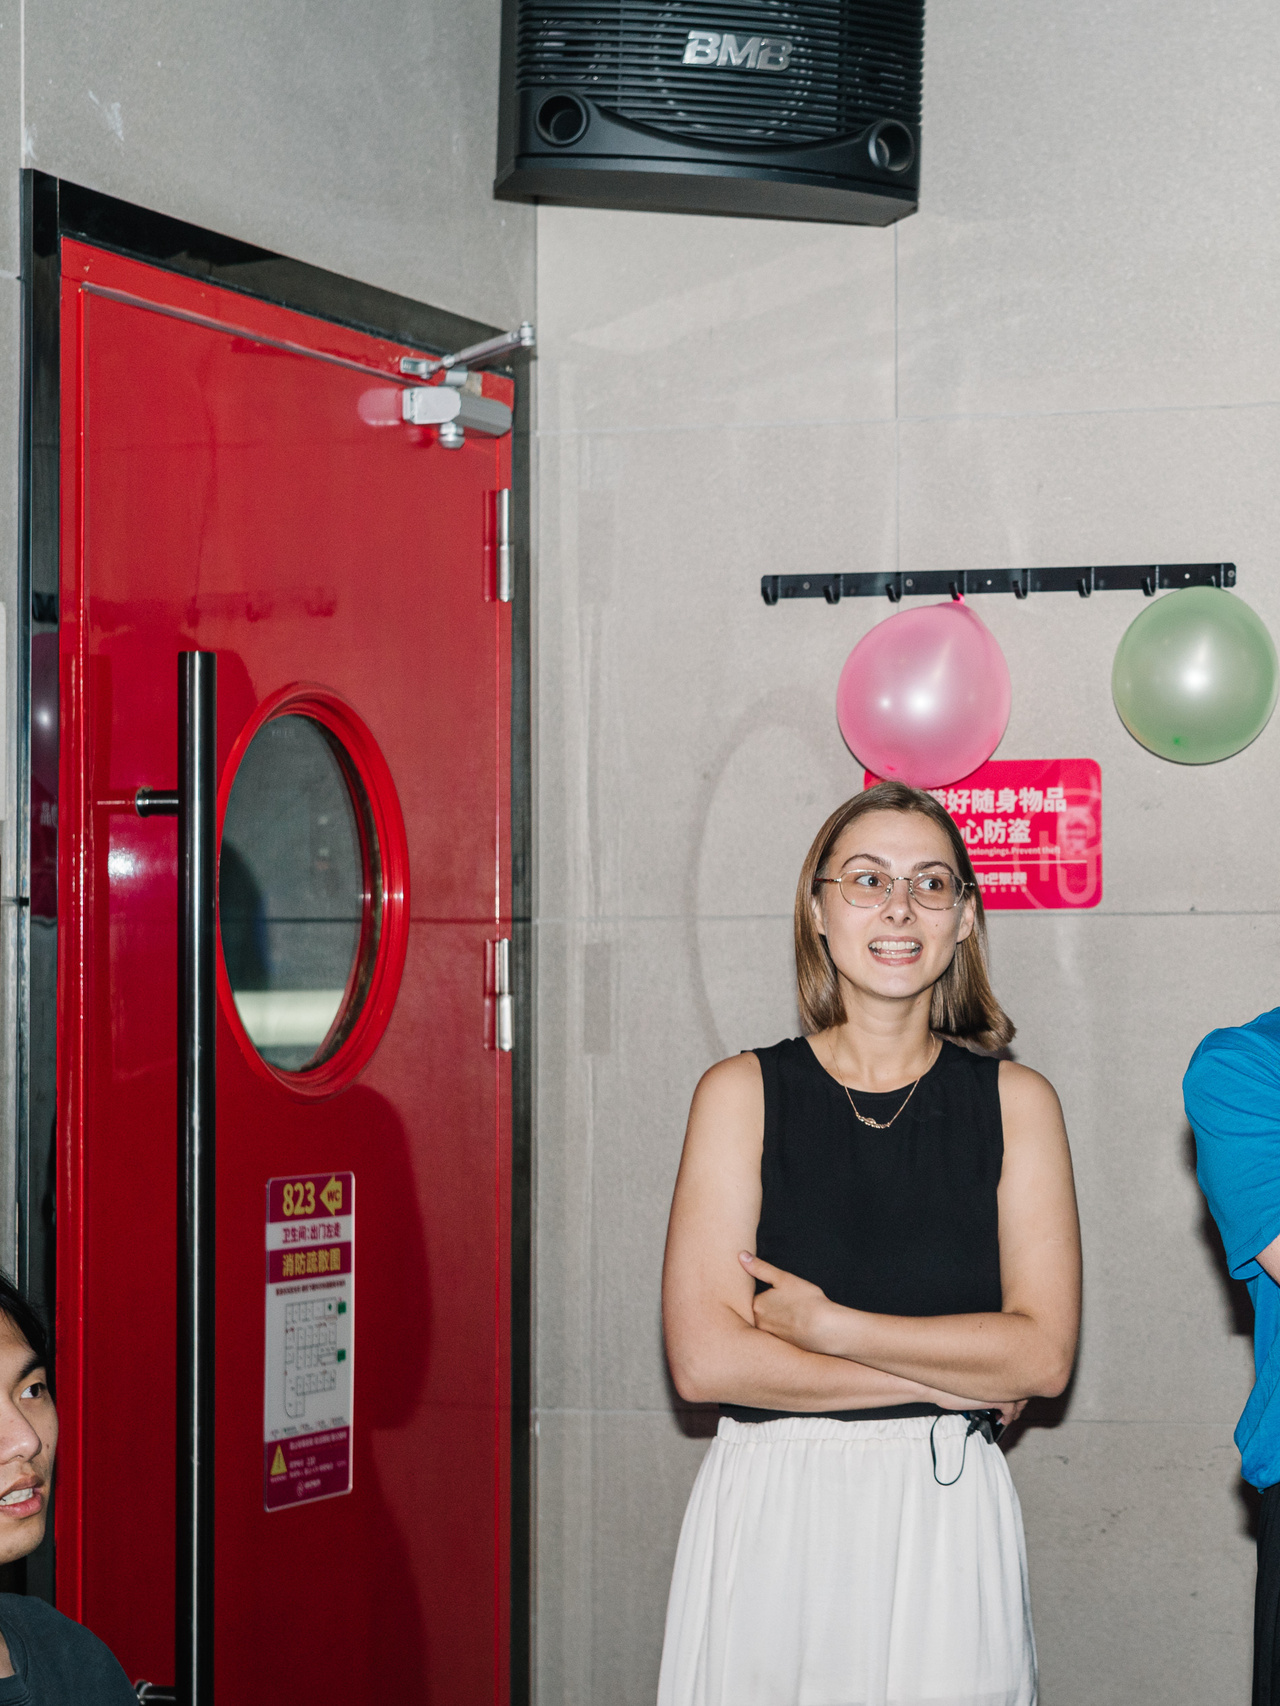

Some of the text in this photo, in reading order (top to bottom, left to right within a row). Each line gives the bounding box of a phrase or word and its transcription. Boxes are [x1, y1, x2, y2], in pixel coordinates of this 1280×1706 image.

[682, 30, 793, 71] BMB
[959, 818, 1031, 844] 心防盗
[282, 1181, 341, 1217] 823 WC
